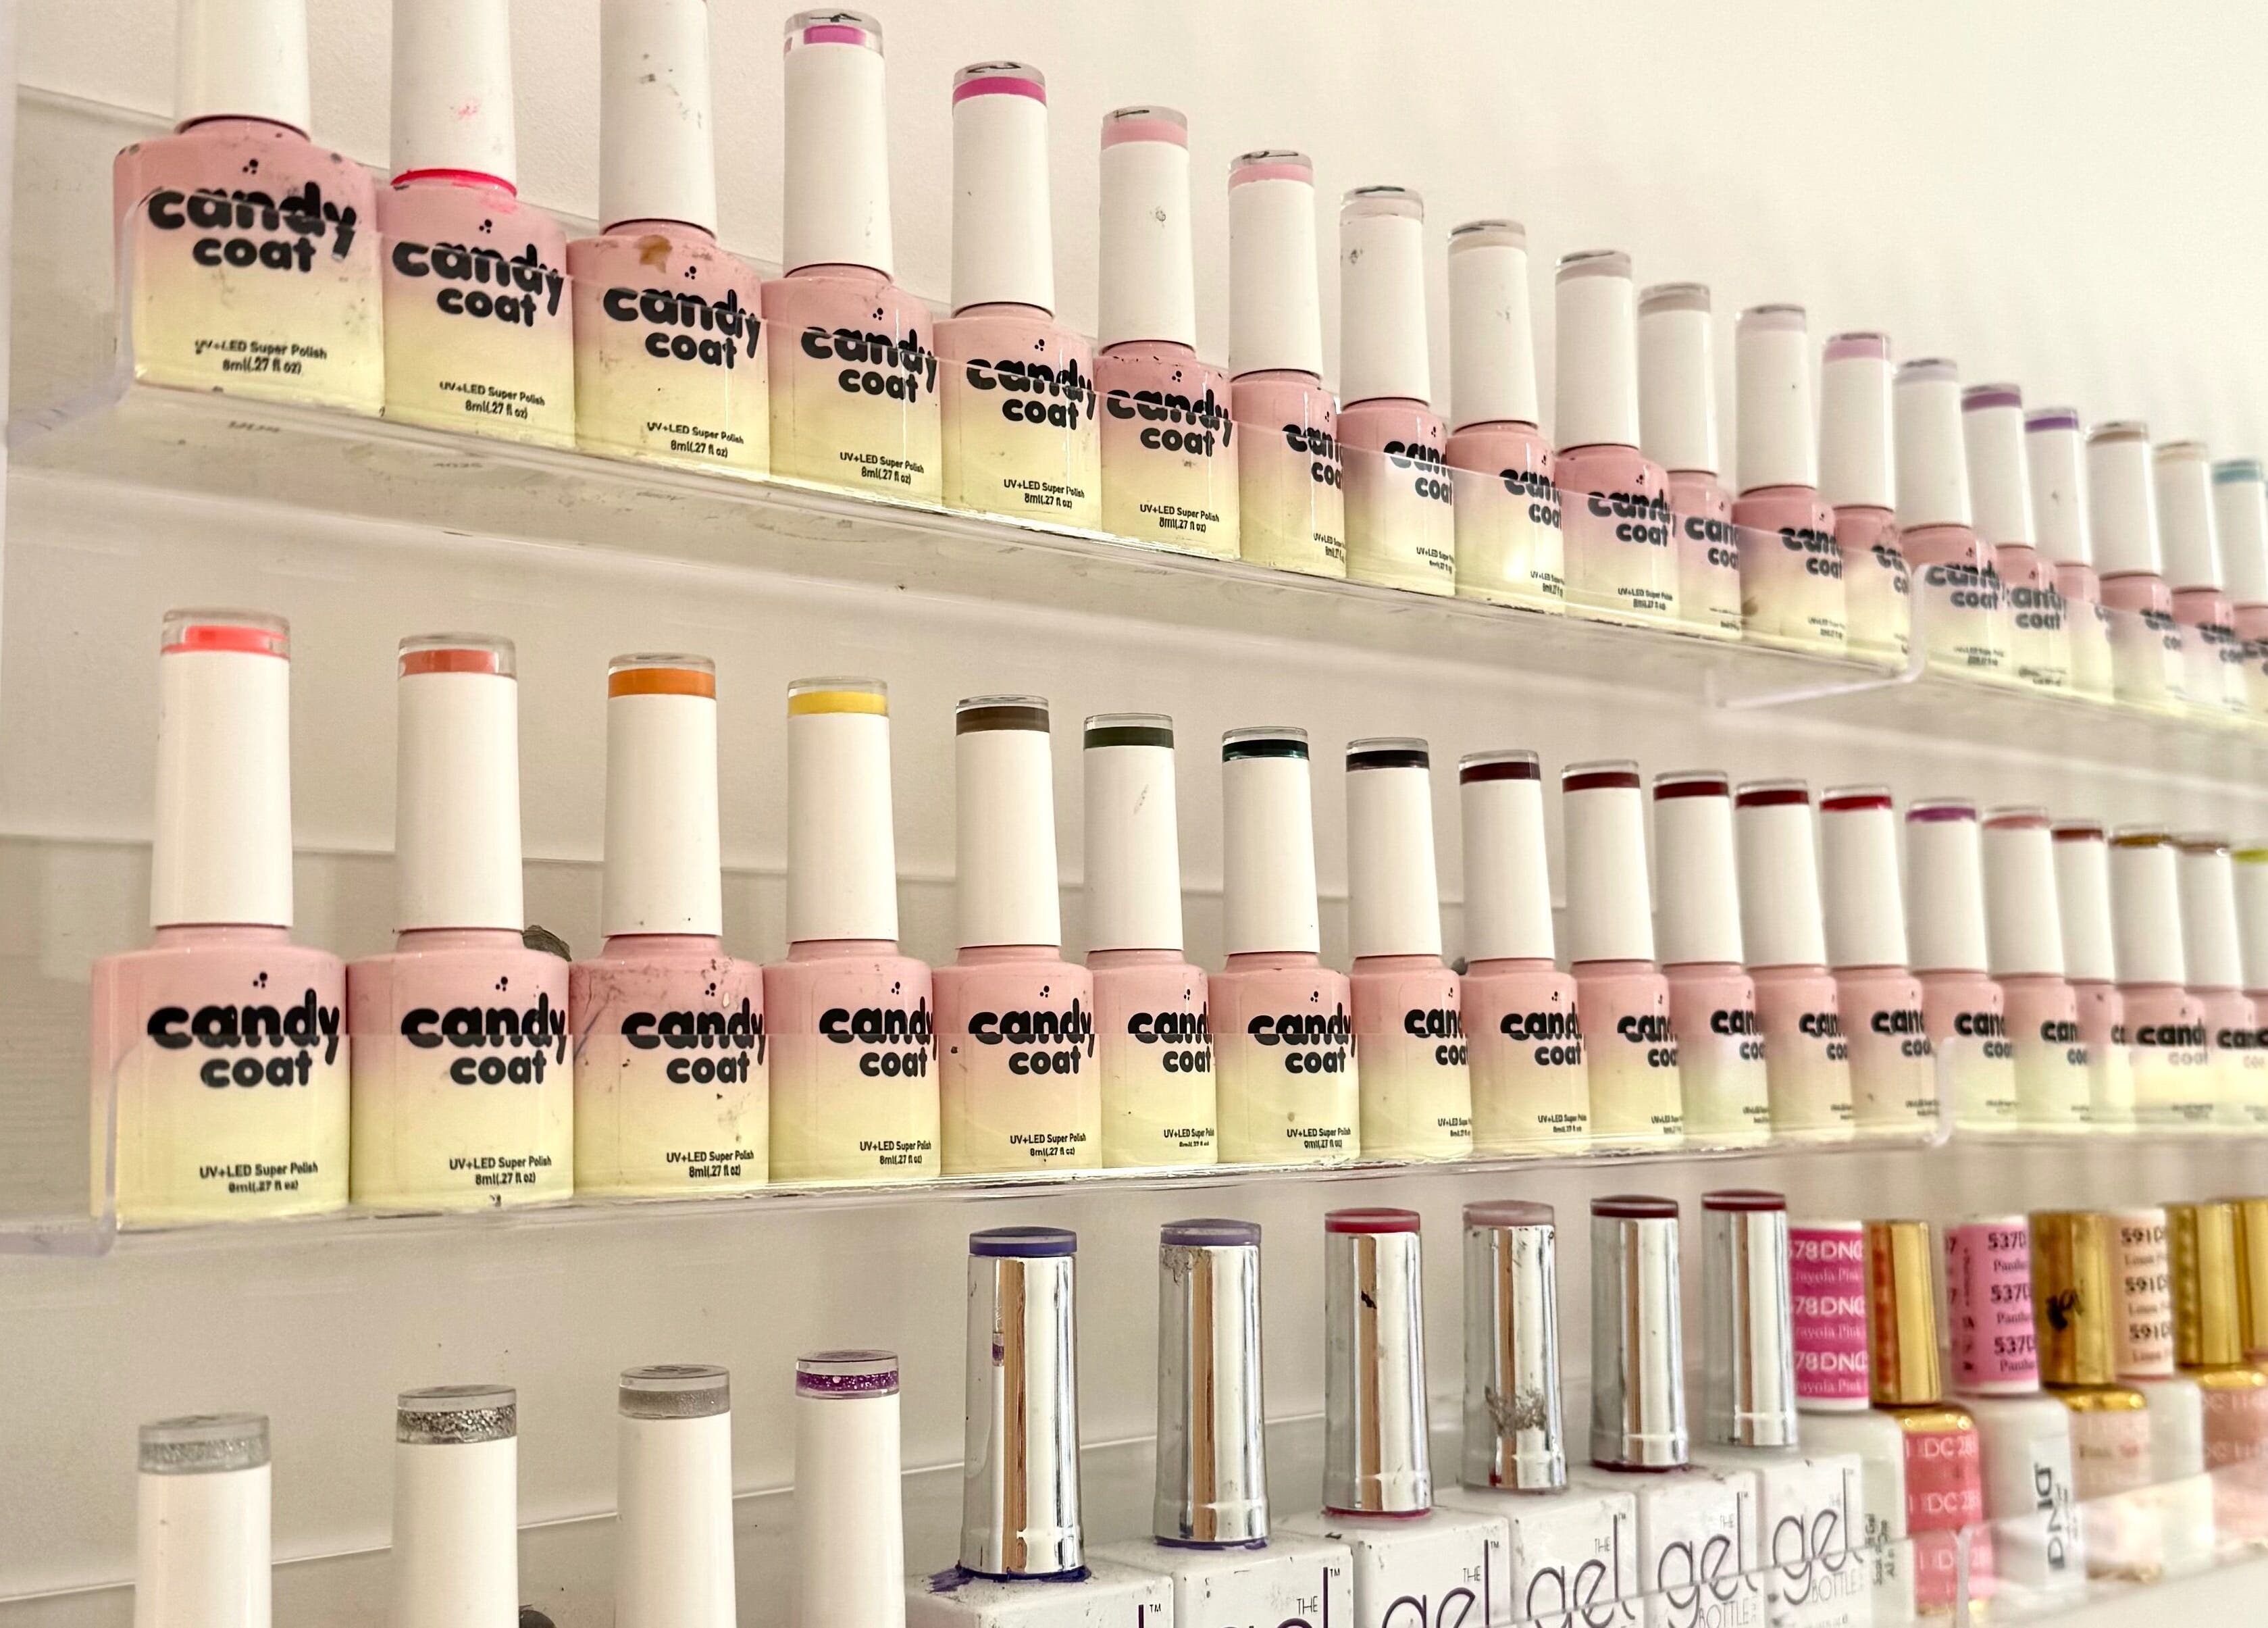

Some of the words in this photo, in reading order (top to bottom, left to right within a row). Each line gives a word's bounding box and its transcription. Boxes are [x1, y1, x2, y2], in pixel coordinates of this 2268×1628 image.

[149, 181, 357, 260] candy
[192, 236, 316, 272] coat
[392, 244, 564, 316] candy
[436, 286, 538, 327] coat
[603, 288, 761, 359] candy
[645, 332, 737, 369] coat
[800, 326, 937, 393] candy
[488, 386, 517, 400] Super
[838, 368, 918, 403] coat
[967, 358, 1096, 420] candy
[1002, 398, 1079, 430] coat
[1106, 388, 1233, 447] candy
[647, 422, 690, 434] UV+LED
[692, 426, 719, 439] Super
[1140, 428, 1215, 457] coat
[840, 452, 878, 464] UV+LED
[880, 456, 903, 468] Super
[1282, 424, 1343, 469] can
[1384, 441, 1453, 481] can
[1004, 479, 1040, 490] UV+LED
[1042, 482, 1064, 494] Super
[1312, 462, 1342, 490] coa
[1499, 469, 1562, 506] can
[1140, 504, 1175, 514] UV+LED
[1177, 507, 1199, 518] Super
[1528, 503, 1562, 530] coa
[1616, 524, 1668, 547] coat
[1684, 516, 1739, 549] can
[1778, 528, 1843, 557] can
[1708, 547, 1739, 569] coa
[1951, 591, 1998, 610] coat
[2015, 611, 2060, 630] coat
[147, 988, 339, 1065] candy
[401, 992, 565, 1064] candy
[621, 997, 765, 1065] candy
[819, 996, 937, 1061] candy
[968, 998, 1094, 1058] candy
[1128, 1001, 1214, 1047] cand
[1404, 1009, 1466, 1038] can
[1500, 1001, 1583, 1044] cand
[1617, 1015, 1677, 1042] can
[1710, 1009, 1760, 1036] can
[1799, 1013, 1840, 1037] can
[1871, 1010, 1925, 1035] can
[1954, 1012, 2005, 1037] can
[2040, 1020, 2078, 1042] can
[2136, 1018, 2207, 1047] cand
[860, 1046, 927, 1077] coat
[1008, 1045, 1081, 1075] coat
[1163, 1046, 1211, 1073] coat
[1285, 1046, 1346, 1074] coat
[1435, 1045, 1468, 1065] coa
[1535, 1041, 1581, 1066] coat
[1648, 1048, 1678, 1067] coa
[1739, 1042, 1766, 1060] co
[1827, 1043, 1847, 1060] co
[1901, 1039, 1931, 1057] coa
[1983, 1041, 2012, 1059] coa
[201, 1050, 312, 1088] coat
[450, 1050, 546, 1086] coat
[666, 1050, 750, 1084] coat
[860, 1141, 894, 1151] UV+LED
[896, 1141, 916, 1152] Super
[1010, 1134, 1045, 1144] UV+LED
[1047, 1134, 1068, 1145] Super
[1164, 1129, 1190, 1138] UV+LED
[449, 1157, 496, 1170] UV+LED
[498, 1156, 526, 1171] Super
[667, 1152, 707, 1163] UV+LED
[709, 1151, 733, 1163] Super
[1793, 1296, 1865, 1317] 78DN
[1795, 1351, 1867, 1373] 78DN
[1595, 1537, 1611, 1552] THE
[1772, 1468, 1863, 1605] gel
[1330, 1568, 1340, 1577] TM
[1462, 1567, 1481, 1583] THE
[1297, 1596, 1318, 1615] THE
